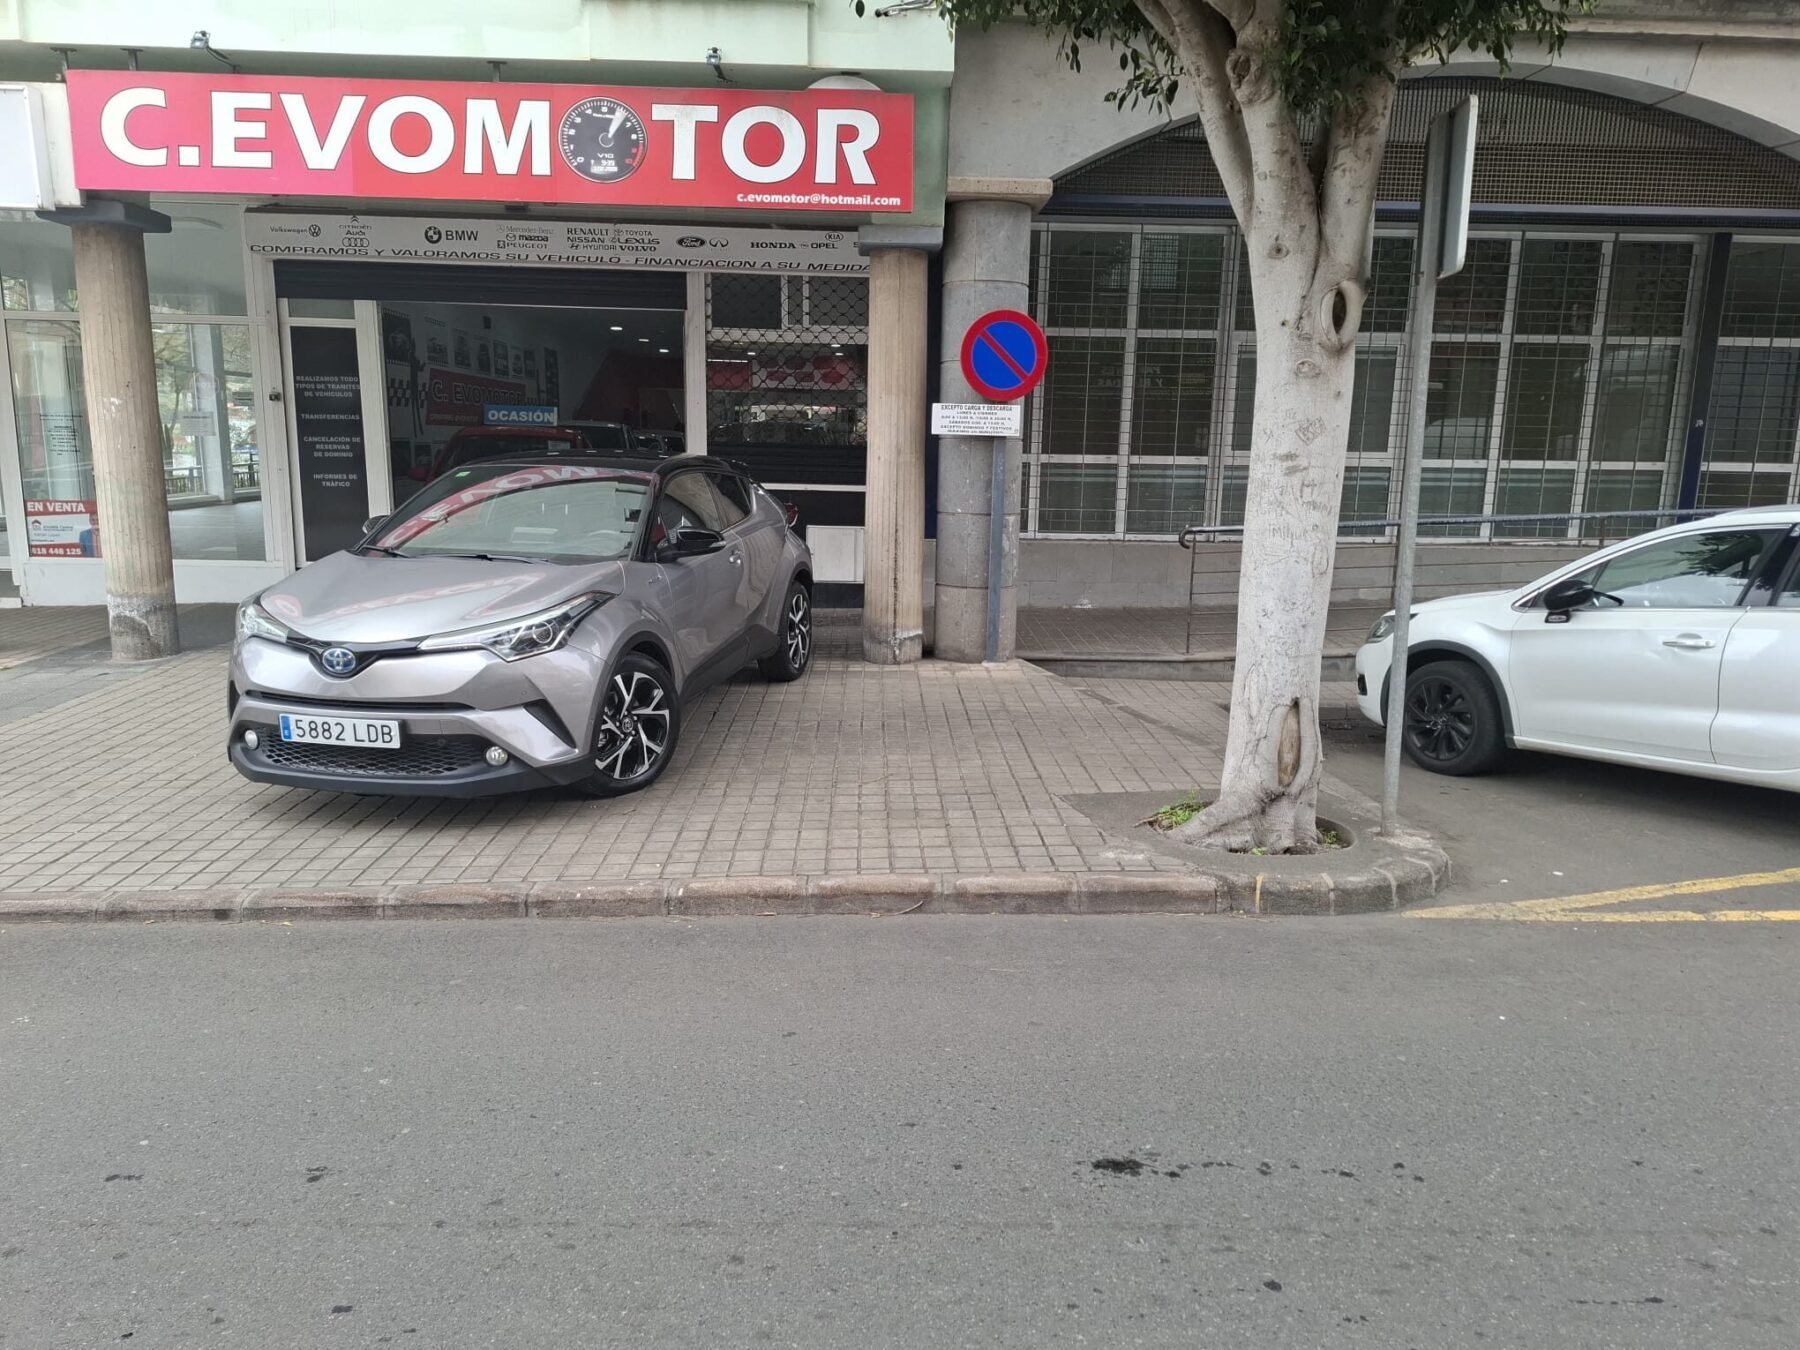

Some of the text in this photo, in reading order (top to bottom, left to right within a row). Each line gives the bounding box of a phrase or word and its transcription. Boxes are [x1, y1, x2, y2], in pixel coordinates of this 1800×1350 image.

[737, 193, 901, 206] c.evomotor@hotmail.com
[270, 225, 308, 234] Volkswagen
[567, 228, 609, 236] RENAULT
[446, 230, 479, 241] BMW
[827, 232, 841, 241] KIA
[620, 244, 656, 252] VOLVO
[250, 244, 369, 256] COMPRAMOS
[375, 248, 385, 256] Y
[392, 249, 501, 260] VALORAMOS
[505, 253, 529, 261] SU
[537, 254, 621, 264] VEHICULO
[635, 257, 757, 269] FINANCIACION
[761, 261, 772, 269] A
[777, 261, 801, 270] SU
[488, 409, 554, 422] OCASIÓN
[27, 501, 86, 512] EN VENTA
[294, 719, 394, 744] 5882 LDB
